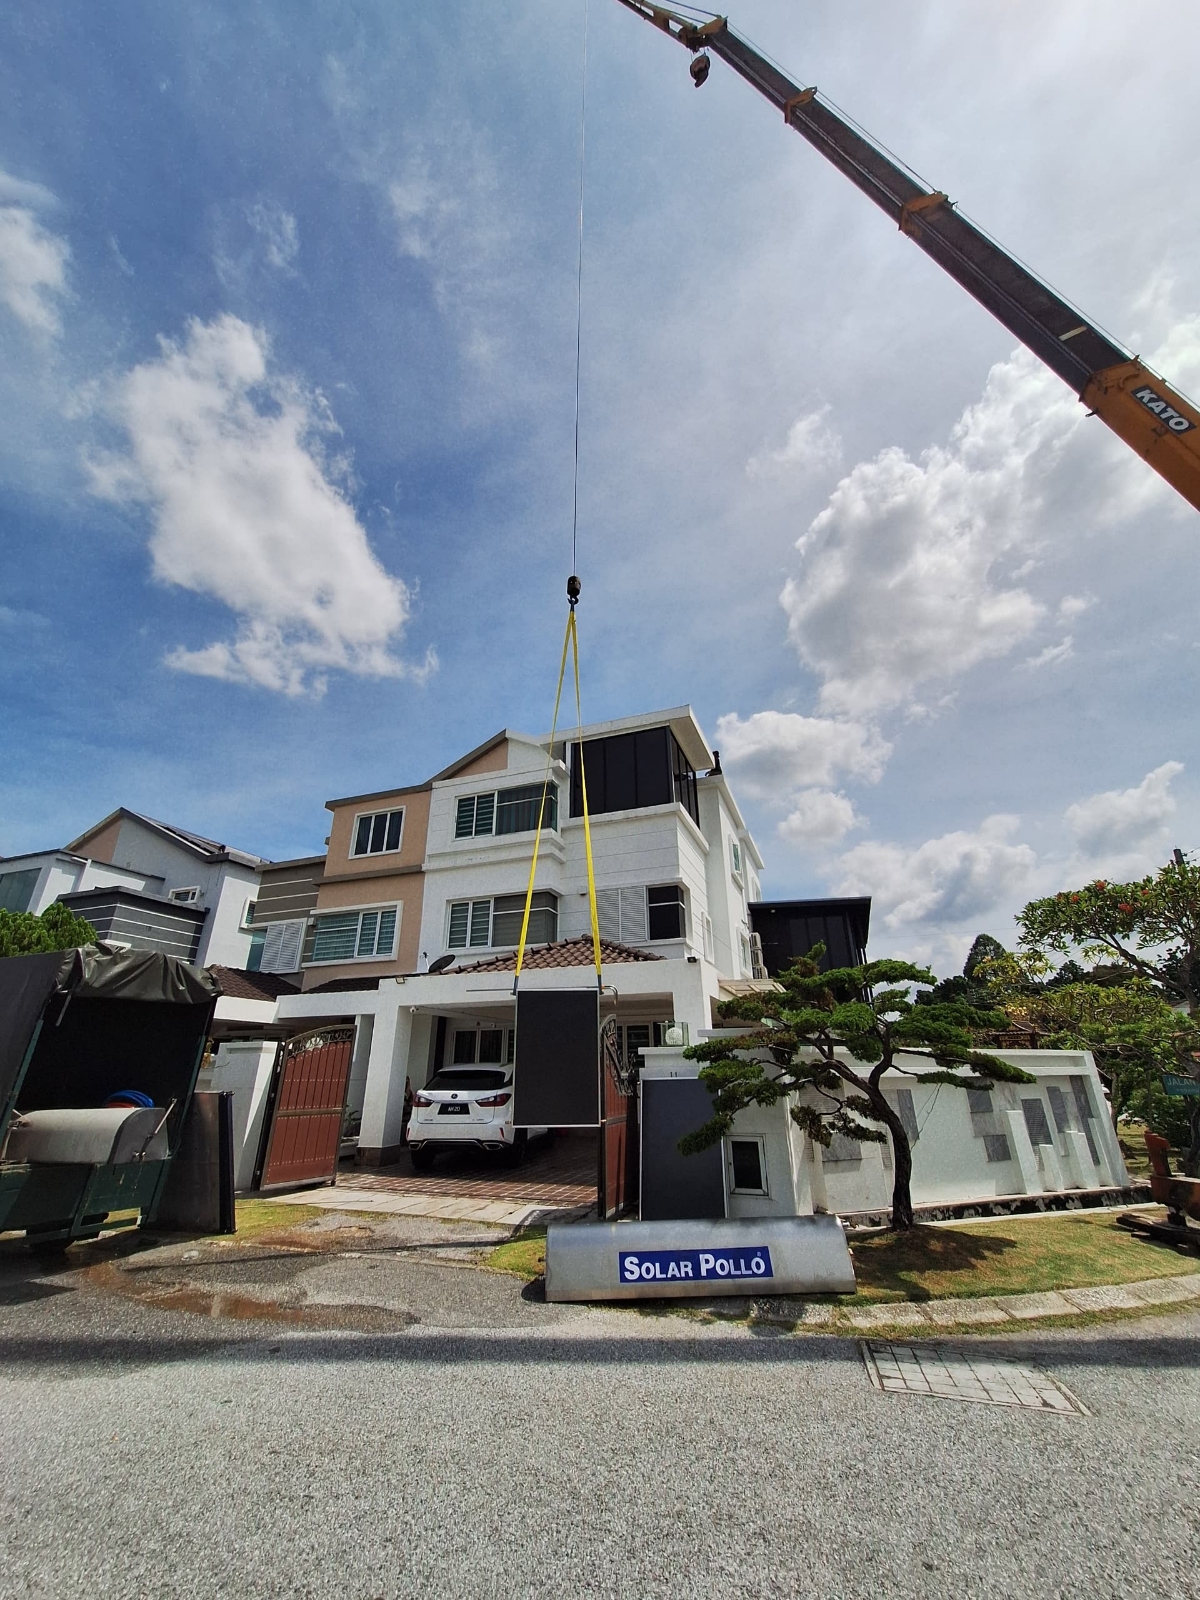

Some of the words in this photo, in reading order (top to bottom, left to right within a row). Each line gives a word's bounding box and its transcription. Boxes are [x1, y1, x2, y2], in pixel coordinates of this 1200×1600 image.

[1135, 389, 1189, 430] KATO
[624, 1256, 693, 1280] SOLAR
[699, 1253, 766, 1277] POLLO
